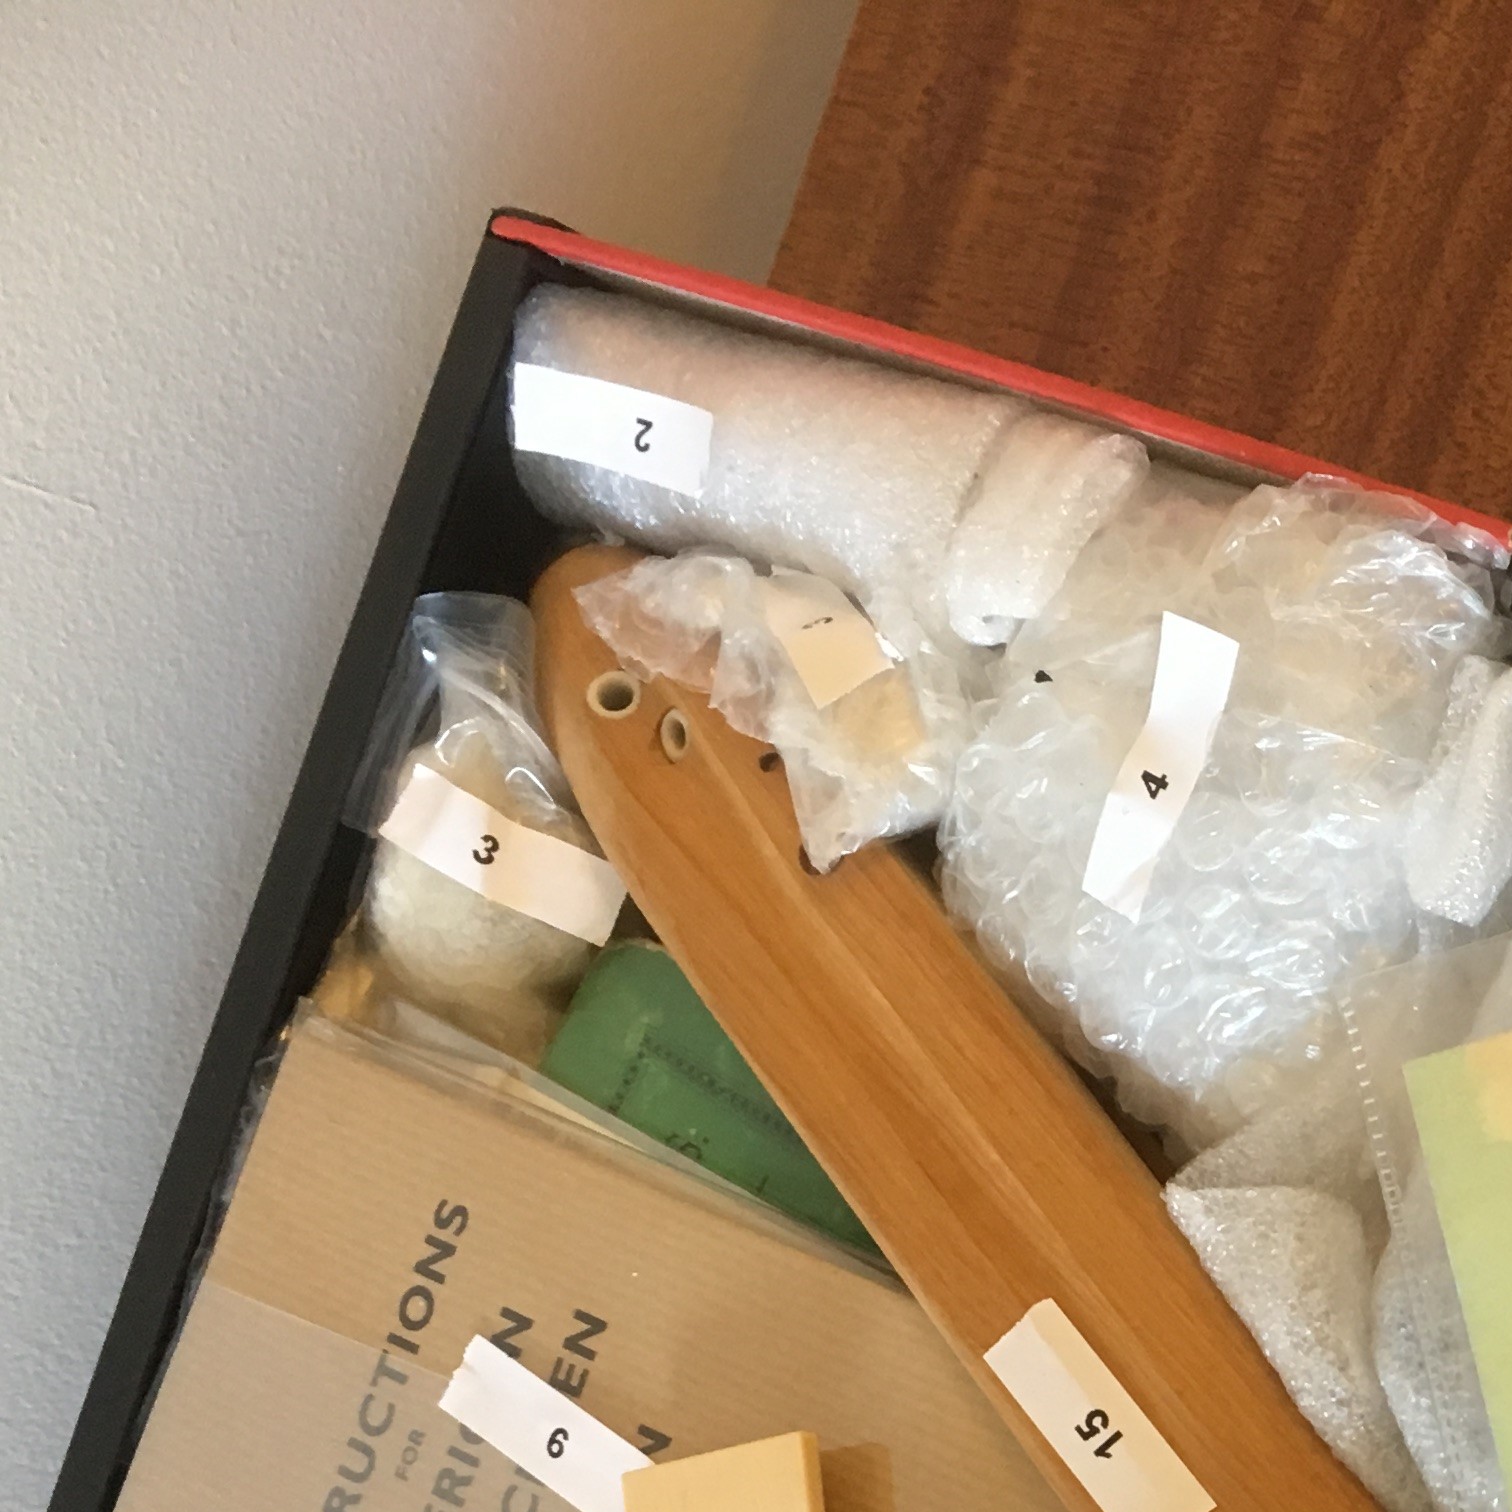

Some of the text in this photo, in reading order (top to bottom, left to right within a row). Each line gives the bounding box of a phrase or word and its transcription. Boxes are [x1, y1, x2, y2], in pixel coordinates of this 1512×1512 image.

[635, 417, 653, 453] 2
[1141, 770, 1169, 800] 4
[472, 834, 499, 865] 3
[1074, 1409, 1124, 1459] 15
[394, 1428, 428, 1482] FOR
